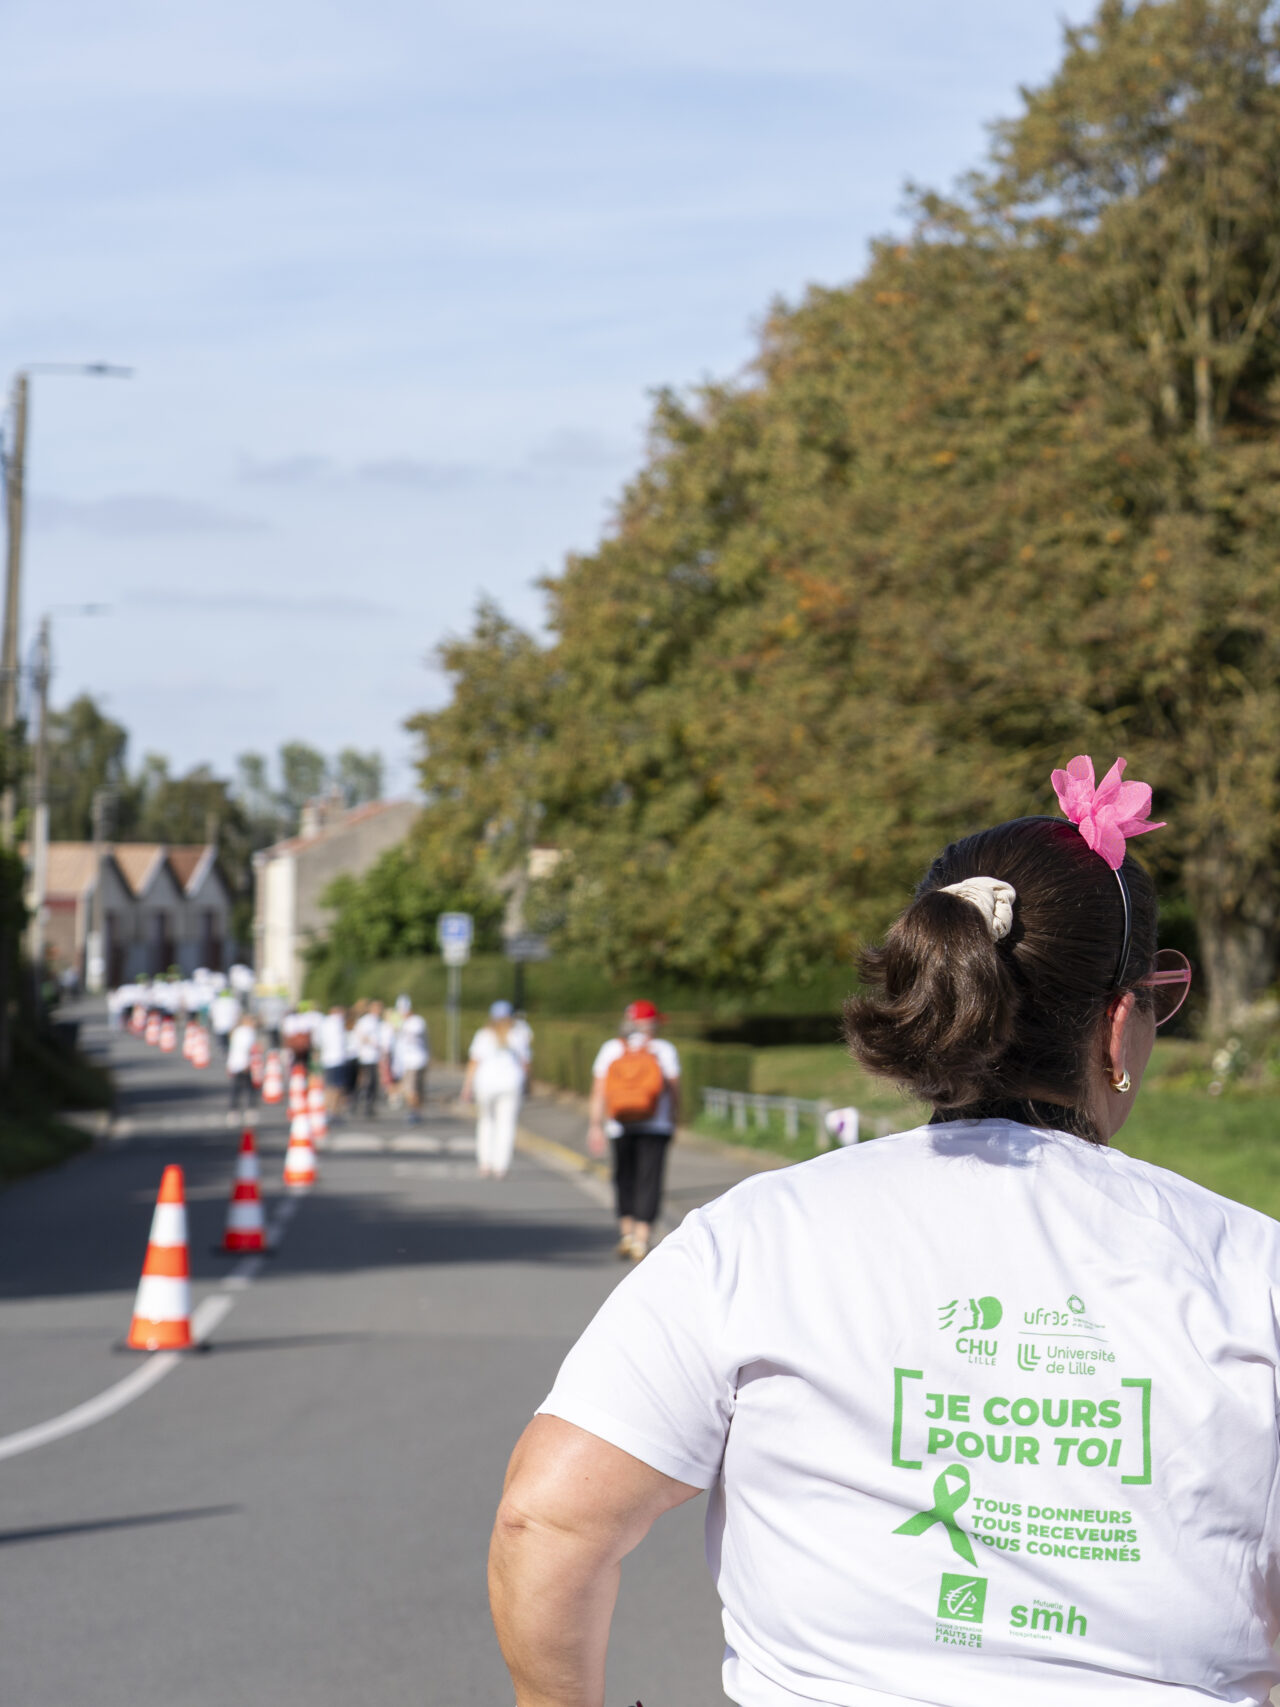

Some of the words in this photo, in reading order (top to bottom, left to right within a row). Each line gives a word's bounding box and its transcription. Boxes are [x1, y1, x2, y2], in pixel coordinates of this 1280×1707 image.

[955, 1337, 998, 1357] CHU
[1047, 1345, 1116, 1363] Université
[968, 1355, 997, 1366] LILLE
[1046, 1361, 1065, 1375] de
[1068, 1361, 1096, 1376] Lille
[924, 1392, 971, 1423] JE
[983, 1396, 1122, 1429] COURS
[927, 1426, 1041, 1465] POUR
[1053, 1437, 1122, 1467] TOI
[973, 1497, 1023, 1516] TOUS
[1027, 1505, 1133, 1524] DONNEURS
[971, 1515, 1022, 1534] TOUS
[1026, 1523, 1138, 1543] RECEVEURS
[970, 1532, 1021, 1552] TOUS
[1026, 1541, 1141, 1562] CONCERNÉS
[1009, 1604, 1088, 1637] smh
[935, 1628, 967, 1639] HAUTS
[969, 1633, 983, 1642] DE
[935, 1635, 983, 1648] FRANCE
